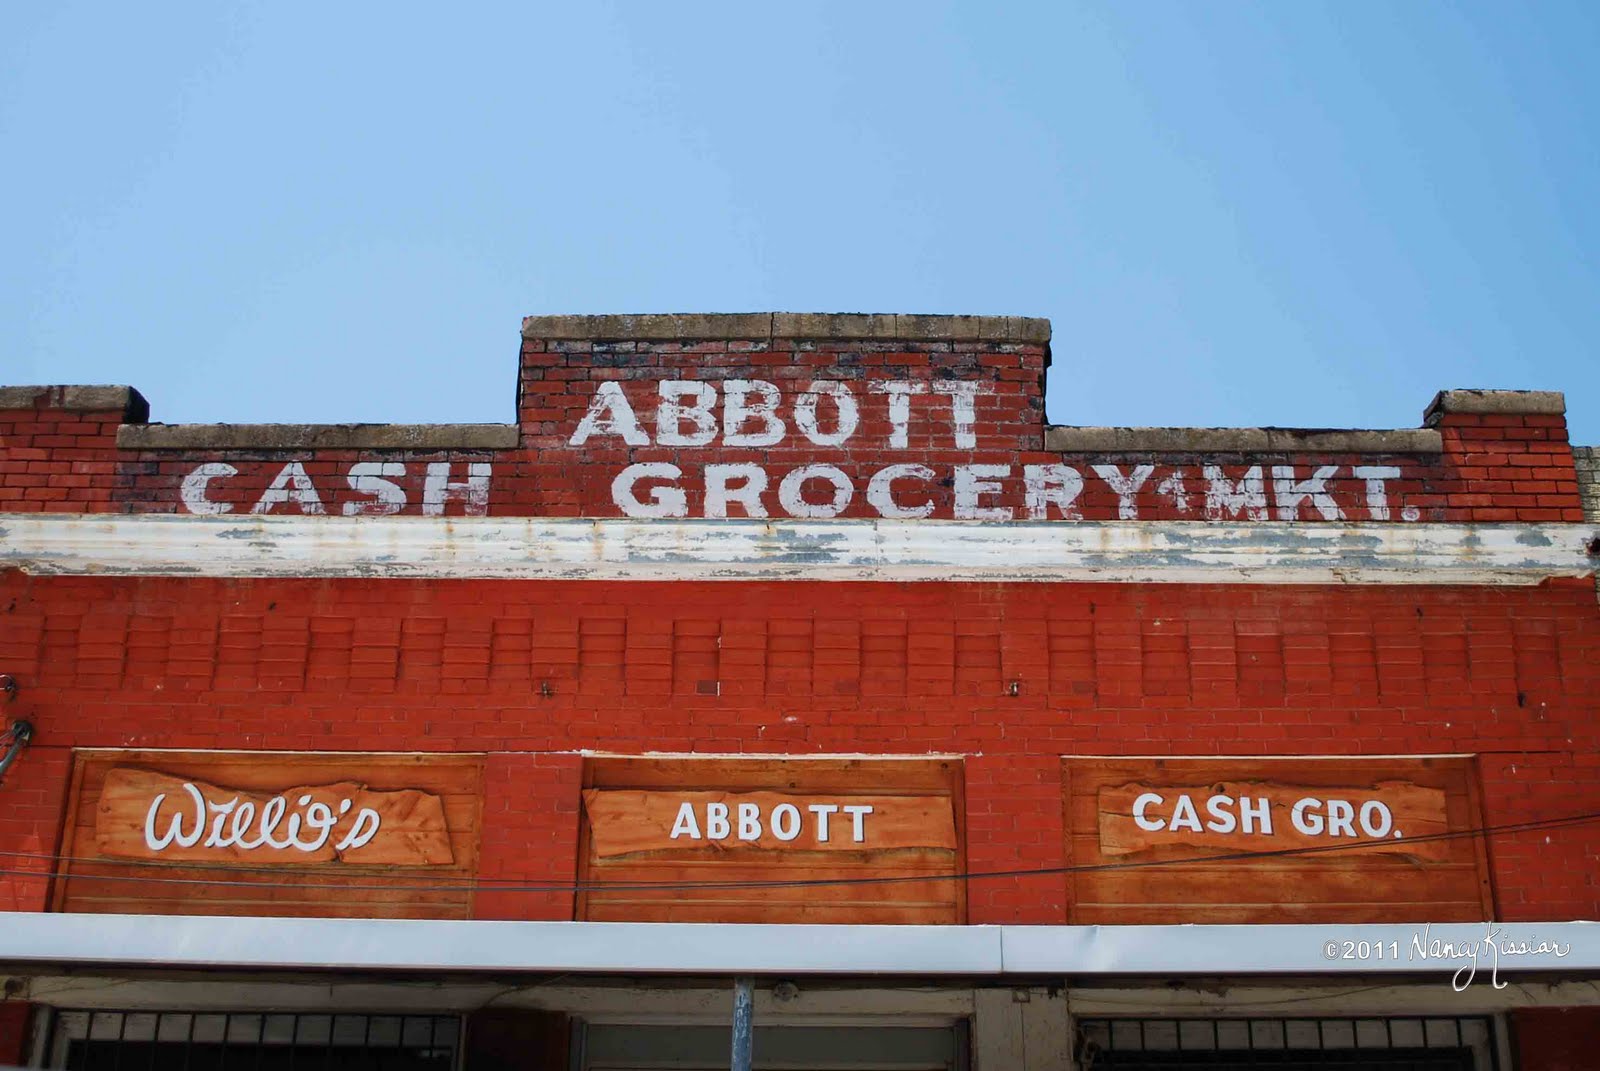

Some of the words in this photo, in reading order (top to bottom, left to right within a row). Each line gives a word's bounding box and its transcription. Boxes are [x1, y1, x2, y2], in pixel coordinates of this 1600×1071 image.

[568, 379, 991, 450] ABBOTT
[180, 461, 493, 516] CASH
[610, 461, 1155, 521] GROCERY
[1202, 463, 1421, 522] MKT.
[669, 801, 874, 843] ABBOTT
[1131, 792, 1273, 835] CASH
[1290, 796, 1404, 840] GRO.
